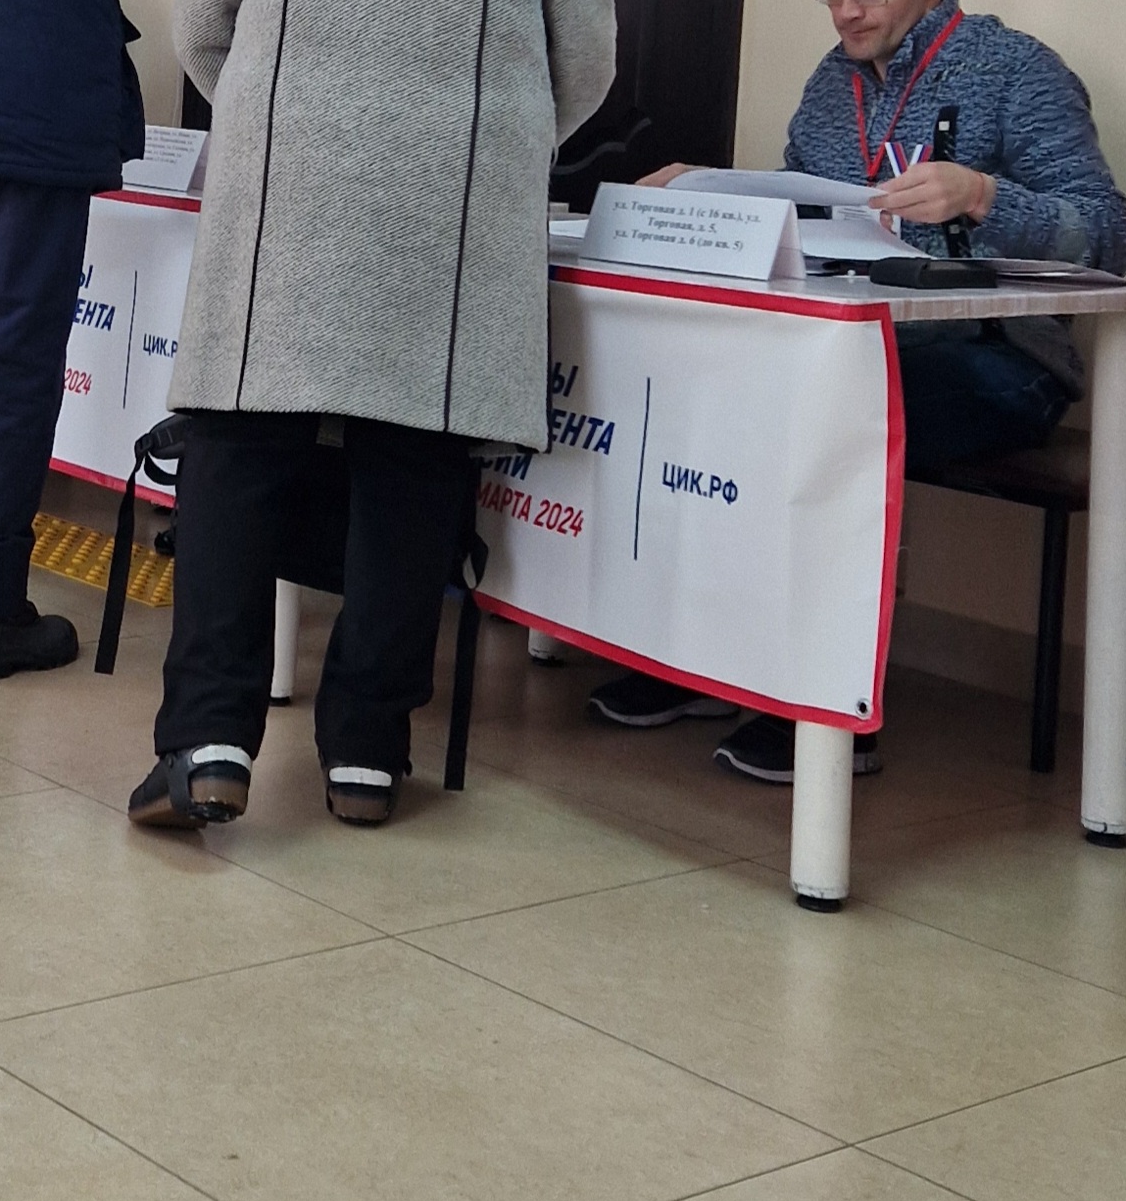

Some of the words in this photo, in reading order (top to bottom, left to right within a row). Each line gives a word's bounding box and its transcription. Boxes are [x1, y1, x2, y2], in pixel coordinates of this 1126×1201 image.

[631, 201, 675, 214] Торговая
[689, 207, 694, 216] 1
[708, 208, 719, 218] 16
[631, 229, 676, 242] Торговая
[689, 235, 695, 245] 6
[143, 333, 178, 358] ЦИК.Р
[64, 368, 92, 395] 2024
[662, 462, 738, 505] ЦИК.РФ
[533, 499, 584, 538] 2024
